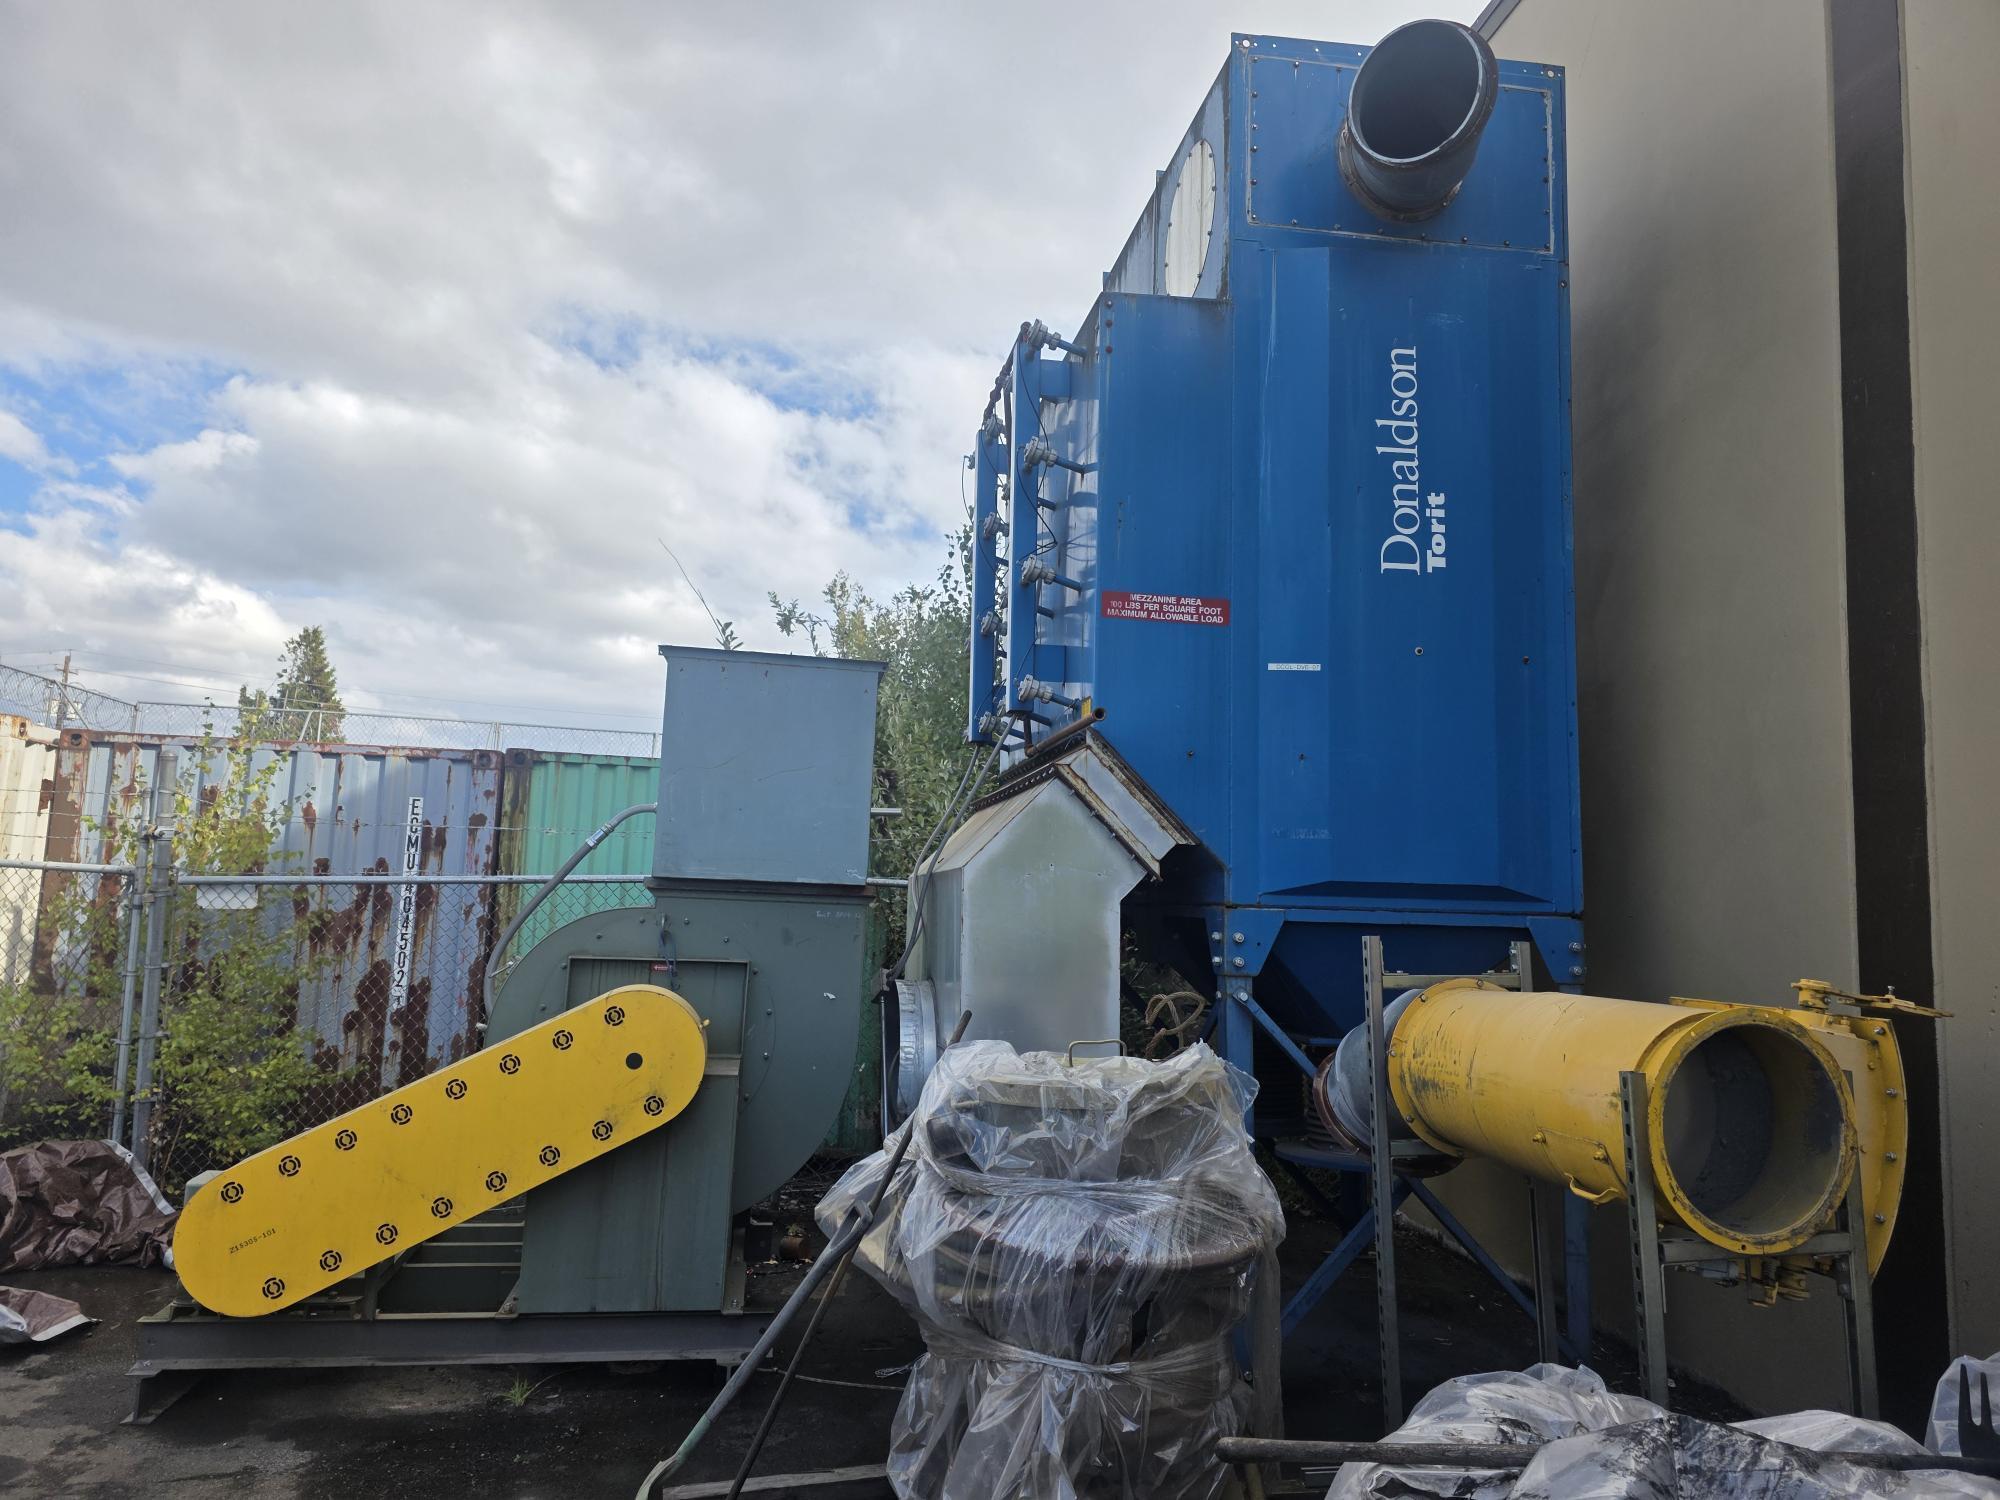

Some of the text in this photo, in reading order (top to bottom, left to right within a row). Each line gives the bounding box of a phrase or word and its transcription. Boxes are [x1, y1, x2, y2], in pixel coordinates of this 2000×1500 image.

[1375, 346, 1420, 576] Donaldson
[1426, 492, 1447, 573] Torit
[1130, 594, 1202, 606] MEZZANINE AREA
[1107, 608, 1224, 624] MAXIMUM ALLOWABLE LOAD
[1125, 602, 1141, 610] LBS
[1143, 602, 1160, 611] PER
[1162, 604, 1197, 614] SQUARE
[1199, 606, 1222, 615] FOOT
